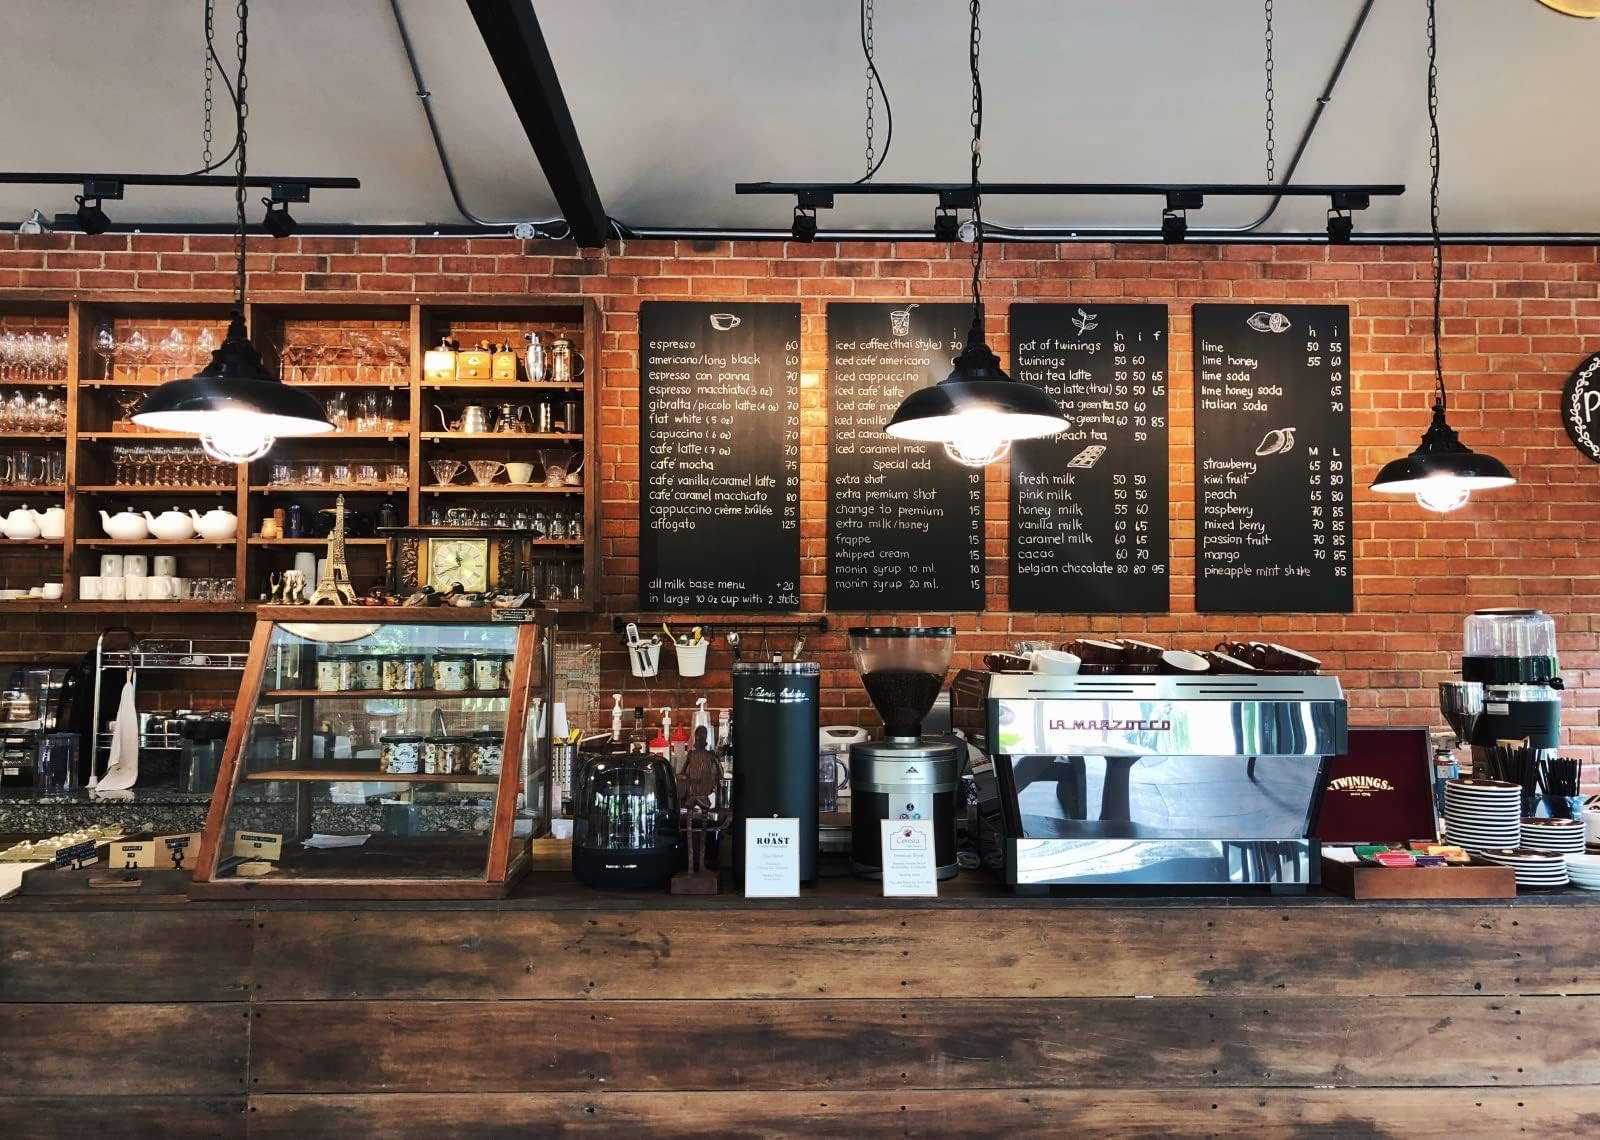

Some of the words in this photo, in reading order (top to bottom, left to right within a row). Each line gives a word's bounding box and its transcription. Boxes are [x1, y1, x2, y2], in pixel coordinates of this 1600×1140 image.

[1116, 330, 1125, 341] h
[650, 341, 696, 351] espresso
[835, 341, 855, 350] iced
[950, 342, 962, 350] 70
[1020, 340, 1036, 355] pot
[1040, 340, 1050, 350] of
[1055, 341, 1101, 354] twinings
[1202, 340, 1224, 352] lime
[732, 355, 760, 364] black
[880, 356, 930, 365] americano
[1019, 356, 1065, 368] twinings
[1115, 357, 1126, 365] 50
[1202, 356, 1222, 365] lime
[1228, 355, 1258, 369] honey
[1307, 357, 1321, 367] 55
[649, 372, 690, 380] espresso
[719, 372, 750, 382] panna
[835, 372, 855, 382] iced
[859, 372, 918, 383] cappuccino
[1020, 371, 1043, 381] thai
[1047, 370, 1065, 381] tea
[1070, 370, 1092, 380] latte
[1152, 372, 1163, 381] 65
[1202, 371, 1222, 380] lime
[1226, 372, 1250, 381] soda
[649, 386, 691, 396] espresso
[787, 387, 798, 395] 70
[835, 386, 853, 396] iced
[884, 386, 904, 397] latte
[1044, 385, 1061, 394] tea
[1202, 386, 1222, 396] lime
[1226, 385, 1253, 399] honey
[1258, 385, 1282, 396] soda
[649, 398, 691, 412] gibralta
[1115, 401, 1128, 410] 50
[1242, 401, 1268, 411] soda
[1331, 402, 1343, 412] 70
[650, 413, 669, 424] flat
[675, 413, 702, 424] white
[857, 416, 887, 425] vanilla
[1077, 415, 1101, 427] green
[1134, 417, 1146, 426] 70
[650, 429, 703, 441] capuccino
[836, 430, 855, 440] iced
[1091, 429, 1107, 440] tea
[678, 443, 702, 454] latte
[785, 446, 798, 456] 70
[836, 444, 854, 454] iced
[860, 444, 899, 454] caramel
[904, 445, 926, 454] mac
[1309, 447, 1318, 456] M
[680, 458, 714, 471] mocha
[912, 459, 931, 471] add
[1203, 458, 1257, 474] strawberry
[755, 475, 776, 487] latte
[836, 473, 859, 484] extra
[864, 474, 887, 484] shot
[1019, 472, 1049, 484] fresh
[1053, 473, 1076, 484] milk
[1135, 475, 1146, 485] 50
[1204, 475, 1223, 484] kiwi
[1226, 472, 1250, 484] fruit
[1331, 476, 1343, 485] 80
[675, 490, 711, 501] caramel
[715, 491, 767, 501] macchiato
[836, 491, 860, 500] extra
[866, 489, 908, 502] premium
[914, 488, 937, 500] shot
[1020, 490, 1043, 503] pink
[1047, 489, 1072, 501] milk
[1205, 489, 1236, 504] peach
[650, 505, 711, 517] cappuccino
[715, 505, 742, 515] crème
[784, 507, 795, 516] 85
[836, 505, 875, 517] change
[880, 505, 892, 514] to
[898, 507, 944, 517] premium
[1019, 505, 1051, 519] honey
[1059, 504, 1083, 516] milk
[1136, 504, 1149, 515] 60
[1205, 503, 1253, 518] raspberry
[1333, 507, 1344, 517] 85
[651, 518, 695, 532] affogato
[836, 520, 863, 529] extra
[1018, 518, 1052, 530] vanilla
[1059, 518, 1083, 530] milk
[1205, 520, 1234, 530] mixed
[1240, 520, 1265, 534] berry
[836, 534, 871, 547] frappe
[1018, 533, 1064, 544] caramel
[1068, 533, 1093, 543] milk
[1136, 536, 1147, 544] 65
[1204, 535, 1242, 548] passion
[1246, 534, 1271, 545] fruit
[1333, 535, 1346, 546] 85
[836, 549, 875, 561] whipped
[1205, 551, 1240, 562] mango
[836, 565, 867, 574] monin
[873, 564, 901, 576] syrup
[970, 565, 979, 573] 10
[1019, 563, 1059, 576] belgian
[1062, 562, 1113, 574] chocolate
[1134, 565, 1145, 574] 80
[1205, 564, 1252, 579] pineapple
[1256, 564, 1281, 576] mint
[1334, 567, 1347, 576] 85
[649, 578, 661, 589] all
[665, 578, 685, 589] milk
[690, 580, 714, 589] base
[718, 581, 745, 590] menu
[836, 580, 867, 589] monin
[873, 581, 902, 592] syrup
[664, 593, 690, 605] large
[721, 596, 739, 606] cup
[742, 594, 762, 604] with
[1049, 719, 1065, 731] LA
[1073, 719, 1171, 731] MARZOCCO
[1330, 775, 1389, 791] TWININGS
[756, 837, 790, 845] ROAST
